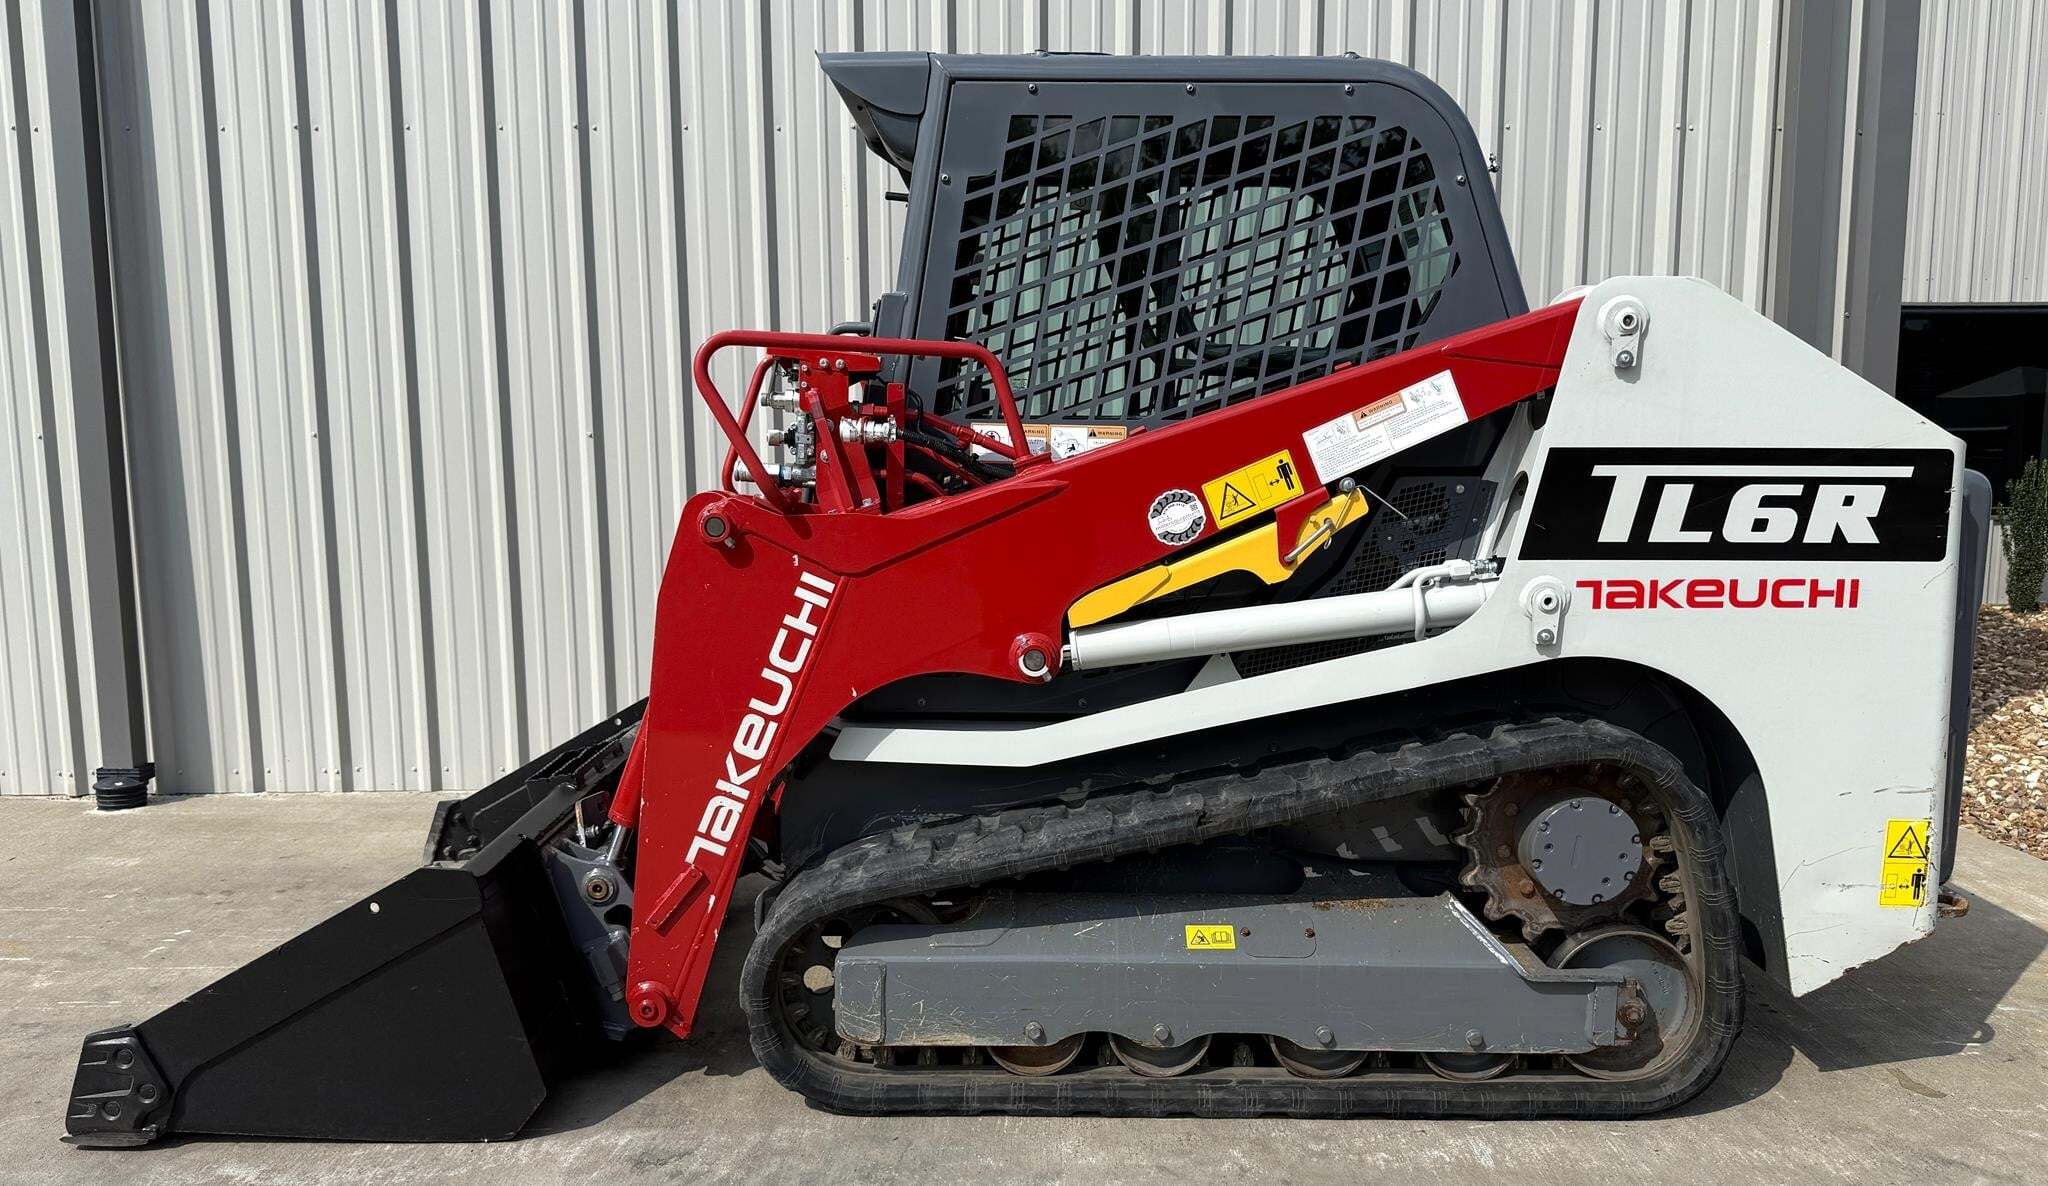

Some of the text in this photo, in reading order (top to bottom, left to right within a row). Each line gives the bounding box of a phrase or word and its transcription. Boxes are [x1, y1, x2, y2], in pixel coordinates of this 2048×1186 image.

[1591, 464, 1915, 544] TL6R
[1576, 578, 1860, 610] TAKEUCHI
[685, 571, 836, 865] TAKEUCHI
